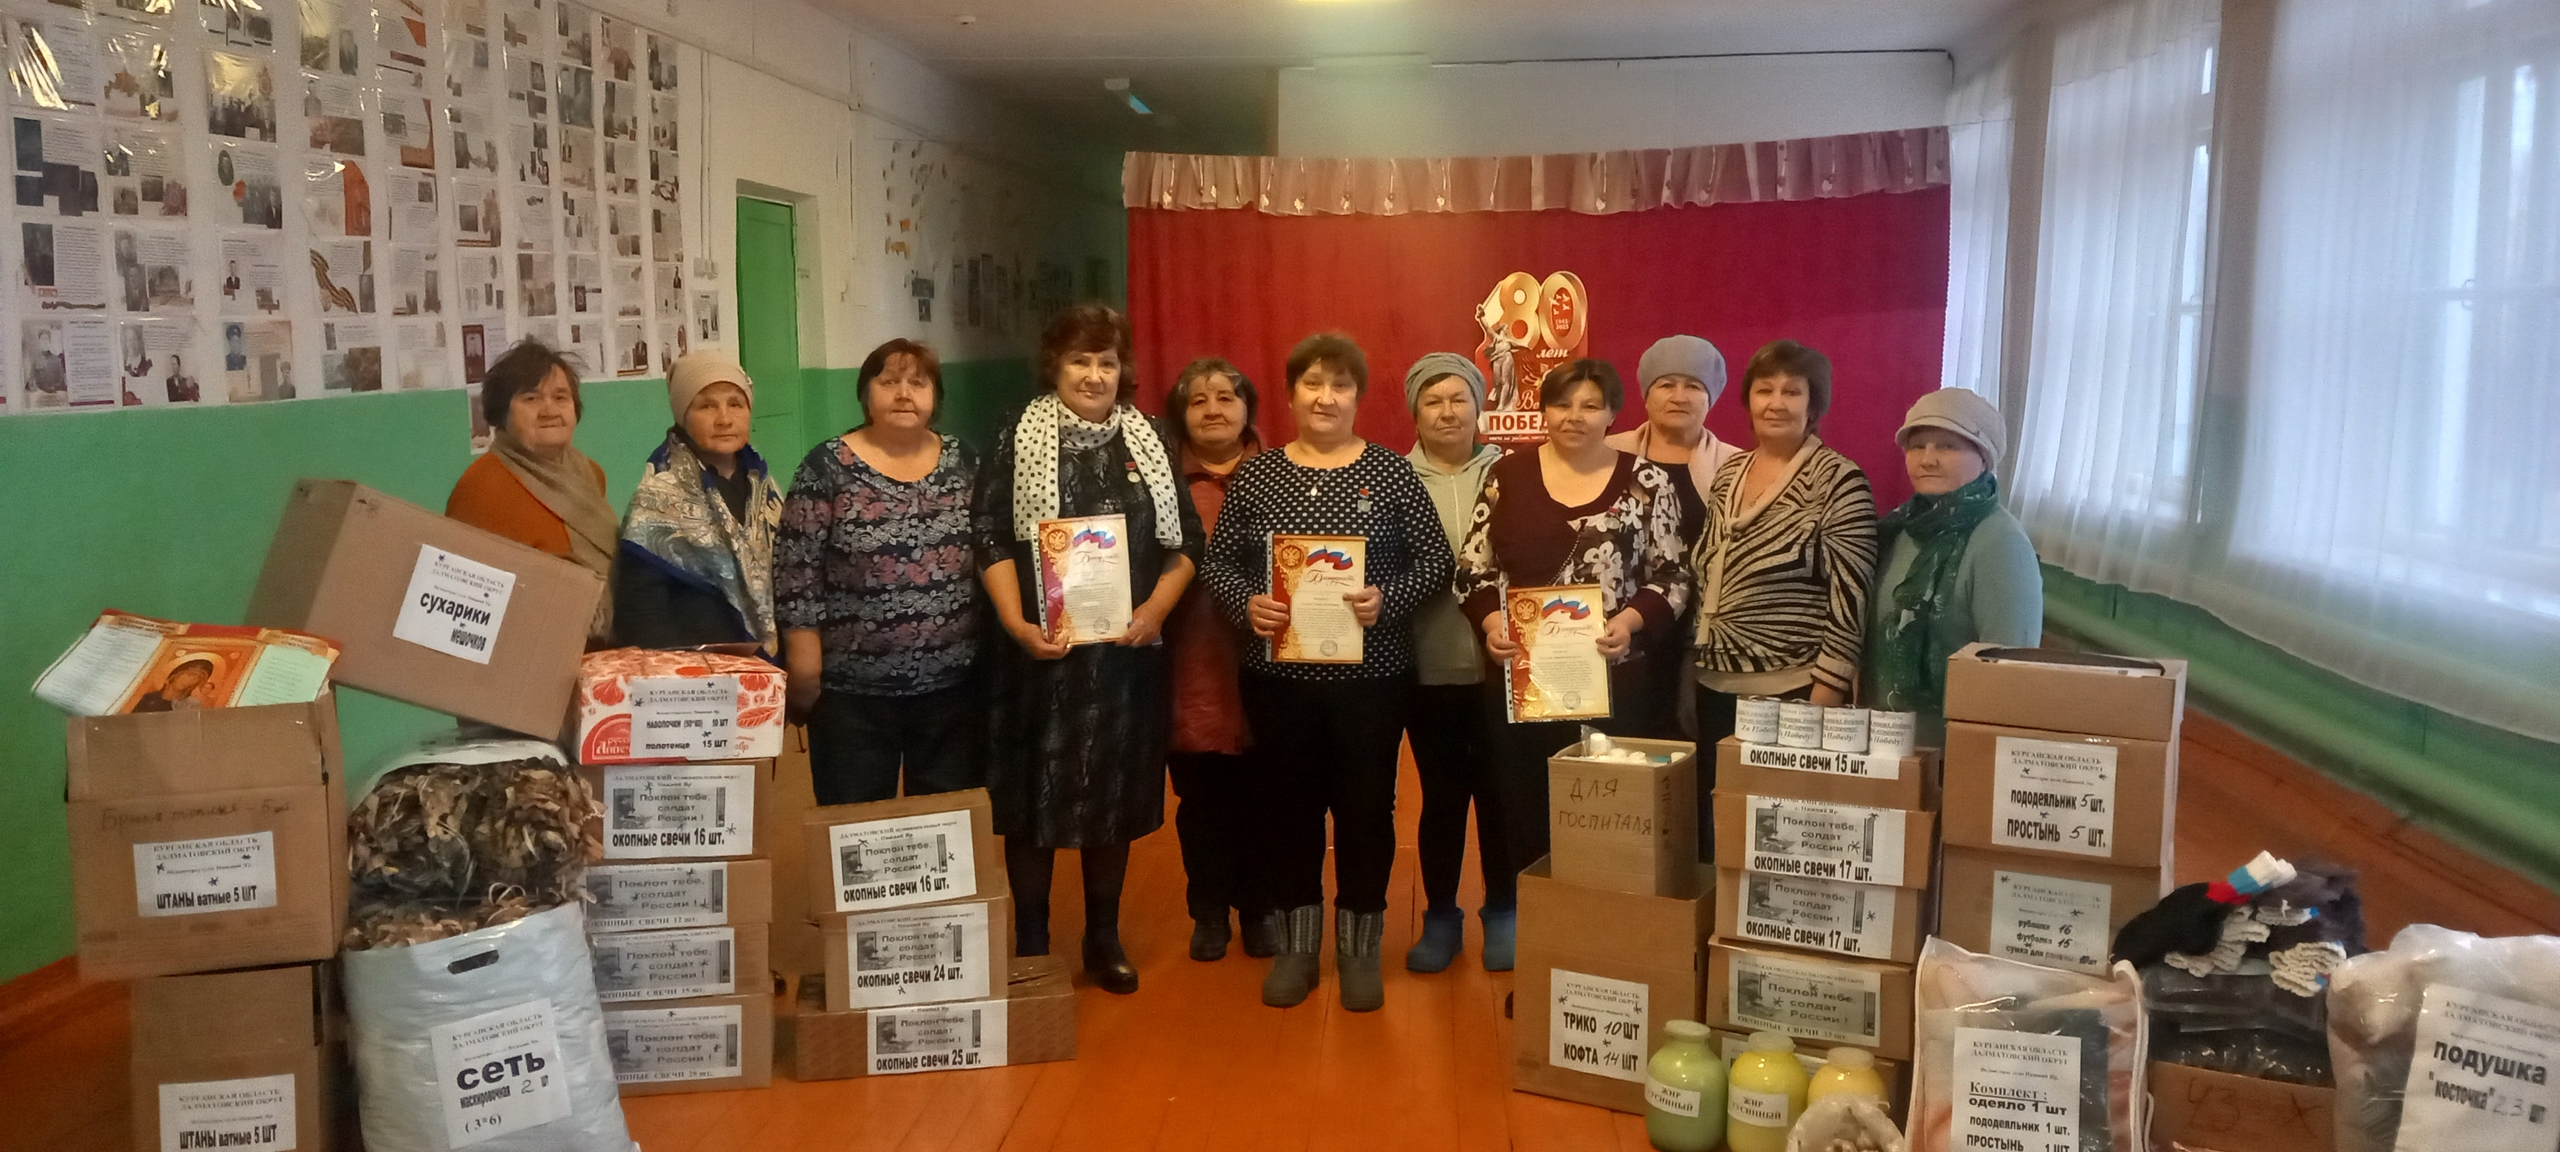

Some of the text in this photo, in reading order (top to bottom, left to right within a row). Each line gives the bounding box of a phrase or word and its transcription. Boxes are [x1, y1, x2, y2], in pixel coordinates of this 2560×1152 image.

[1498, 270, 1588, 351] 80
[1536, 348, 1569, 358] лет
[1489, 414, 1548, 432] ПОБЕД
[420, 593, 491, 626] сухарики
[1750, 750, 1867, 775] окопные свечи 15 шт.
[2011, 750, 2101, 764] КУРГАНСКАЯ ОБЛАСТЬ
[2012, 758, 2078, 770] ДАЛМАТОВСКИЙ
[1570, 777, 1618, 803] ДЛЯ
[2011, 789, 2077, 810] пододеяльник
[2080, 794, 2095, 807] 5
[1559, 810, 1652, 835] ГОСПИТАЛЯ
[1782, 817, 1826, 828] Поклон
[1801, 831, 1841, 841] солдат
[2007, 818, 2086, 842] ПРОСТЫНЬ 5
[612, 828, 724, 847] окопные свечи 16 шт.
[865, 846, 904, 857] Поклон
[1801, 841, 1843, 852] России
[884, 854, 919, 864] солдат
[884, 864, 921, 874] России
[1754, 855, 1872, 882] окопные свечи 17 шт.
[640, 891, 686, 899] солдат
[843, 875, 950, 903] окопные свечи 16 шт.
[1775, 884, 1817, 897] Поклон
[156, 886, 257, 909] ШТАНЫ ватные 5 ШТ
[1793, 899, 1832, 911] солдат
[1792, 909, 1833, 921] России
[882, 933, 920, 943] Поклон
[1746, 921, 1860, 953] окопные свечи 17 шт.
[899, 943, 935, 951] солдат
[2006, 945, 2028, 954] сумка
[626, 951, 675, 960] Поклон
[899, 952, 937, 962] России
[648, 962, 694, 970] солдат
[857, 965, 963, 988] окопные свечи 24 шт.
[1768, 983, 1818, 997] Поклон
[1790, 1000, 1837, 1012] солдат
[1790, 1010, 1840, 1023] России
[452, 1023, 505, 1042] КУРГАНСКАЯ
[918, 1028, 953, 1036] солдат
[1563, 1012, 1639, 1040] ТРИКО 10 ШТ
[635, 1034, 684, 1042] Поклон
[656, 1045, 702, 1053] солдат
[1973, 1041, 2068, 1056] КУРГАНСКАЯ ОБЛАСТЬ
[876, 1049, 981, 1071] окопные свечи 25 шт.
[1564, 1043, 1638, 1072] КОФТА 14 ШТ
[1971, 1050, 2040, 1062] ДАЛМАТОВСКИЙ
[2434, 1041, 2547, 1086] подушка
[456, 1052, 545, 1090] сеть
[521, 1079, 535, 1094] 2
[1661, 1086, 1681, 1099] ЖИР
[1970, 1082, 2039, 1099] Комплект
[1743, 1096, 1763, 1108] ЖИР
[1969, 1098, 2067, 1116] одеяло 1 шт
[1970, 1116, 2070, 1136] пододеяльник 1 шт.
[179, 1124, 277, 1150] ШТАНЫ ватные 5 ШТ
[1966, 1134, 2024, 1151] ПРОСТЫНЬ
